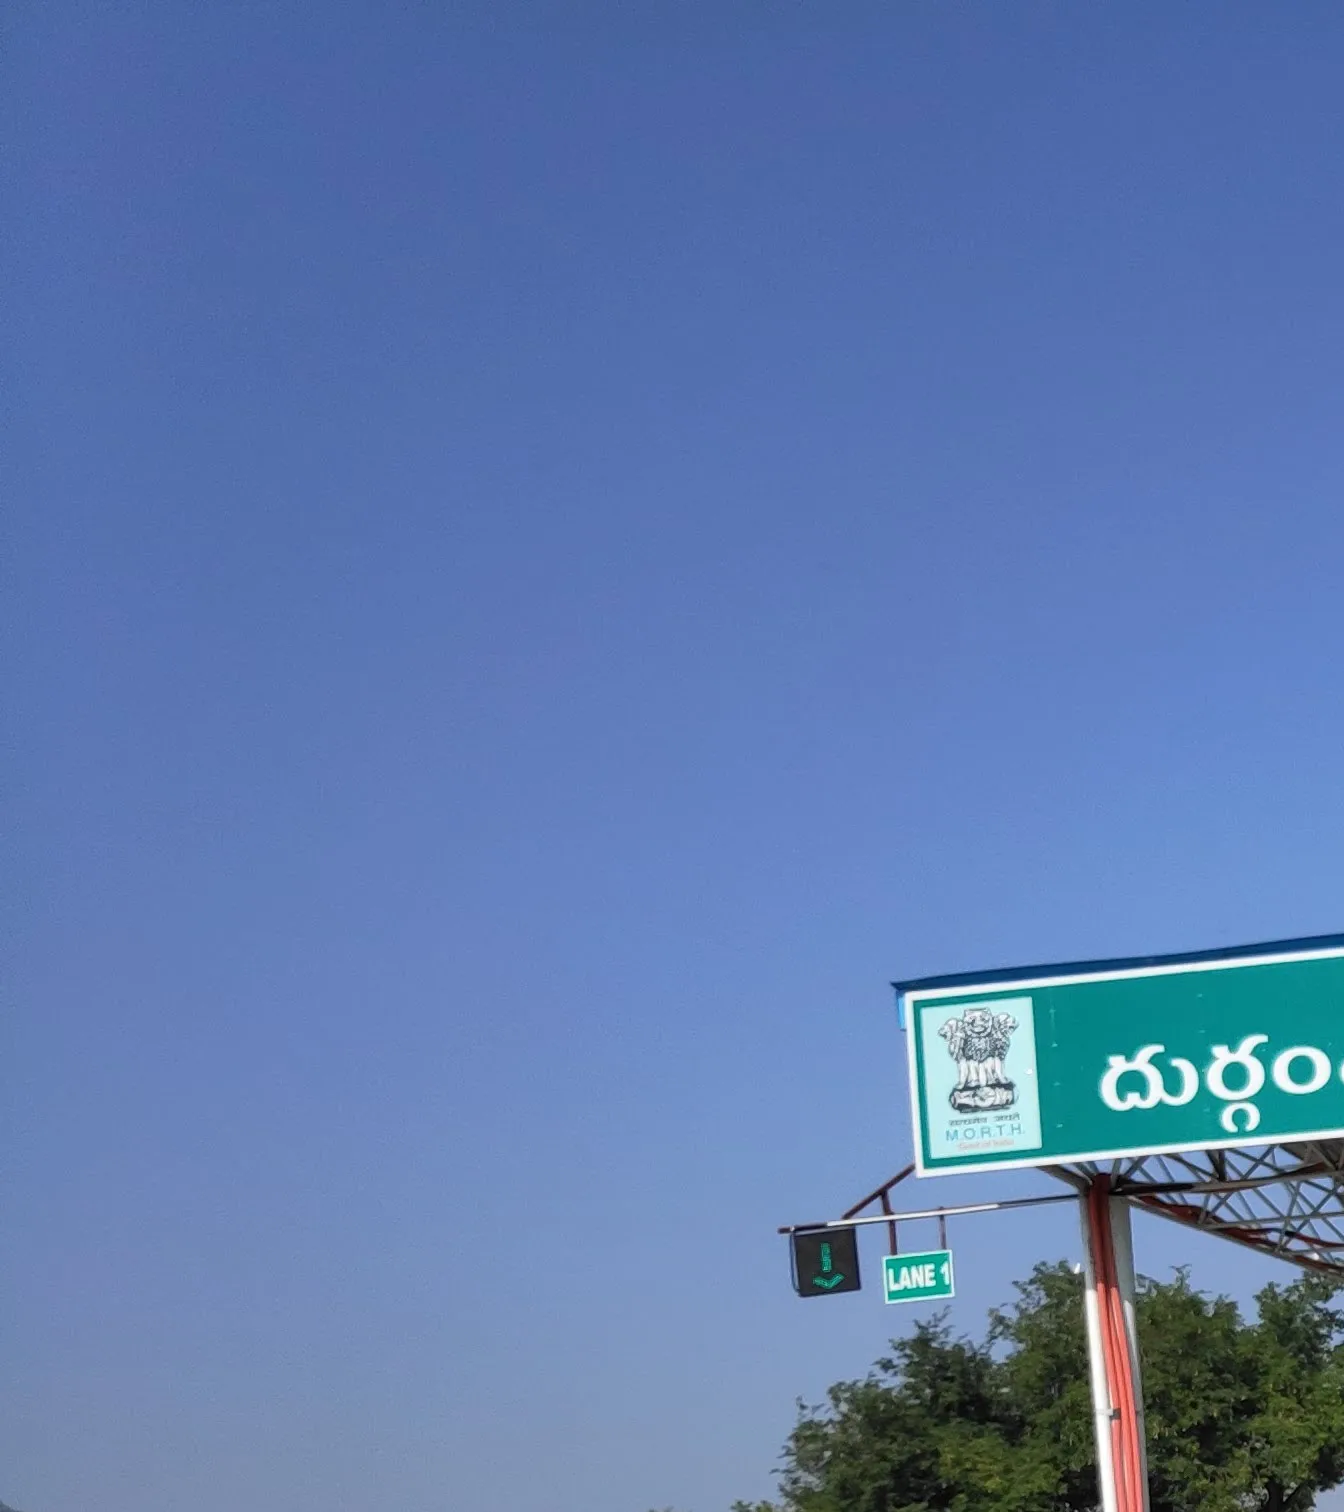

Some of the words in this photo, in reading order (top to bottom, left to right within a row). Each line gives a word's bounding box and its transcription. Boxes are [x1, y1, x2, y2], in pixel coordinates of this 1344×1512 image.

[946, 1123, 1025, 1141] M.O.R.T.H.
[888, 1263, 936, 1291] LANE
[940, 1260, 950, 1285] 1
